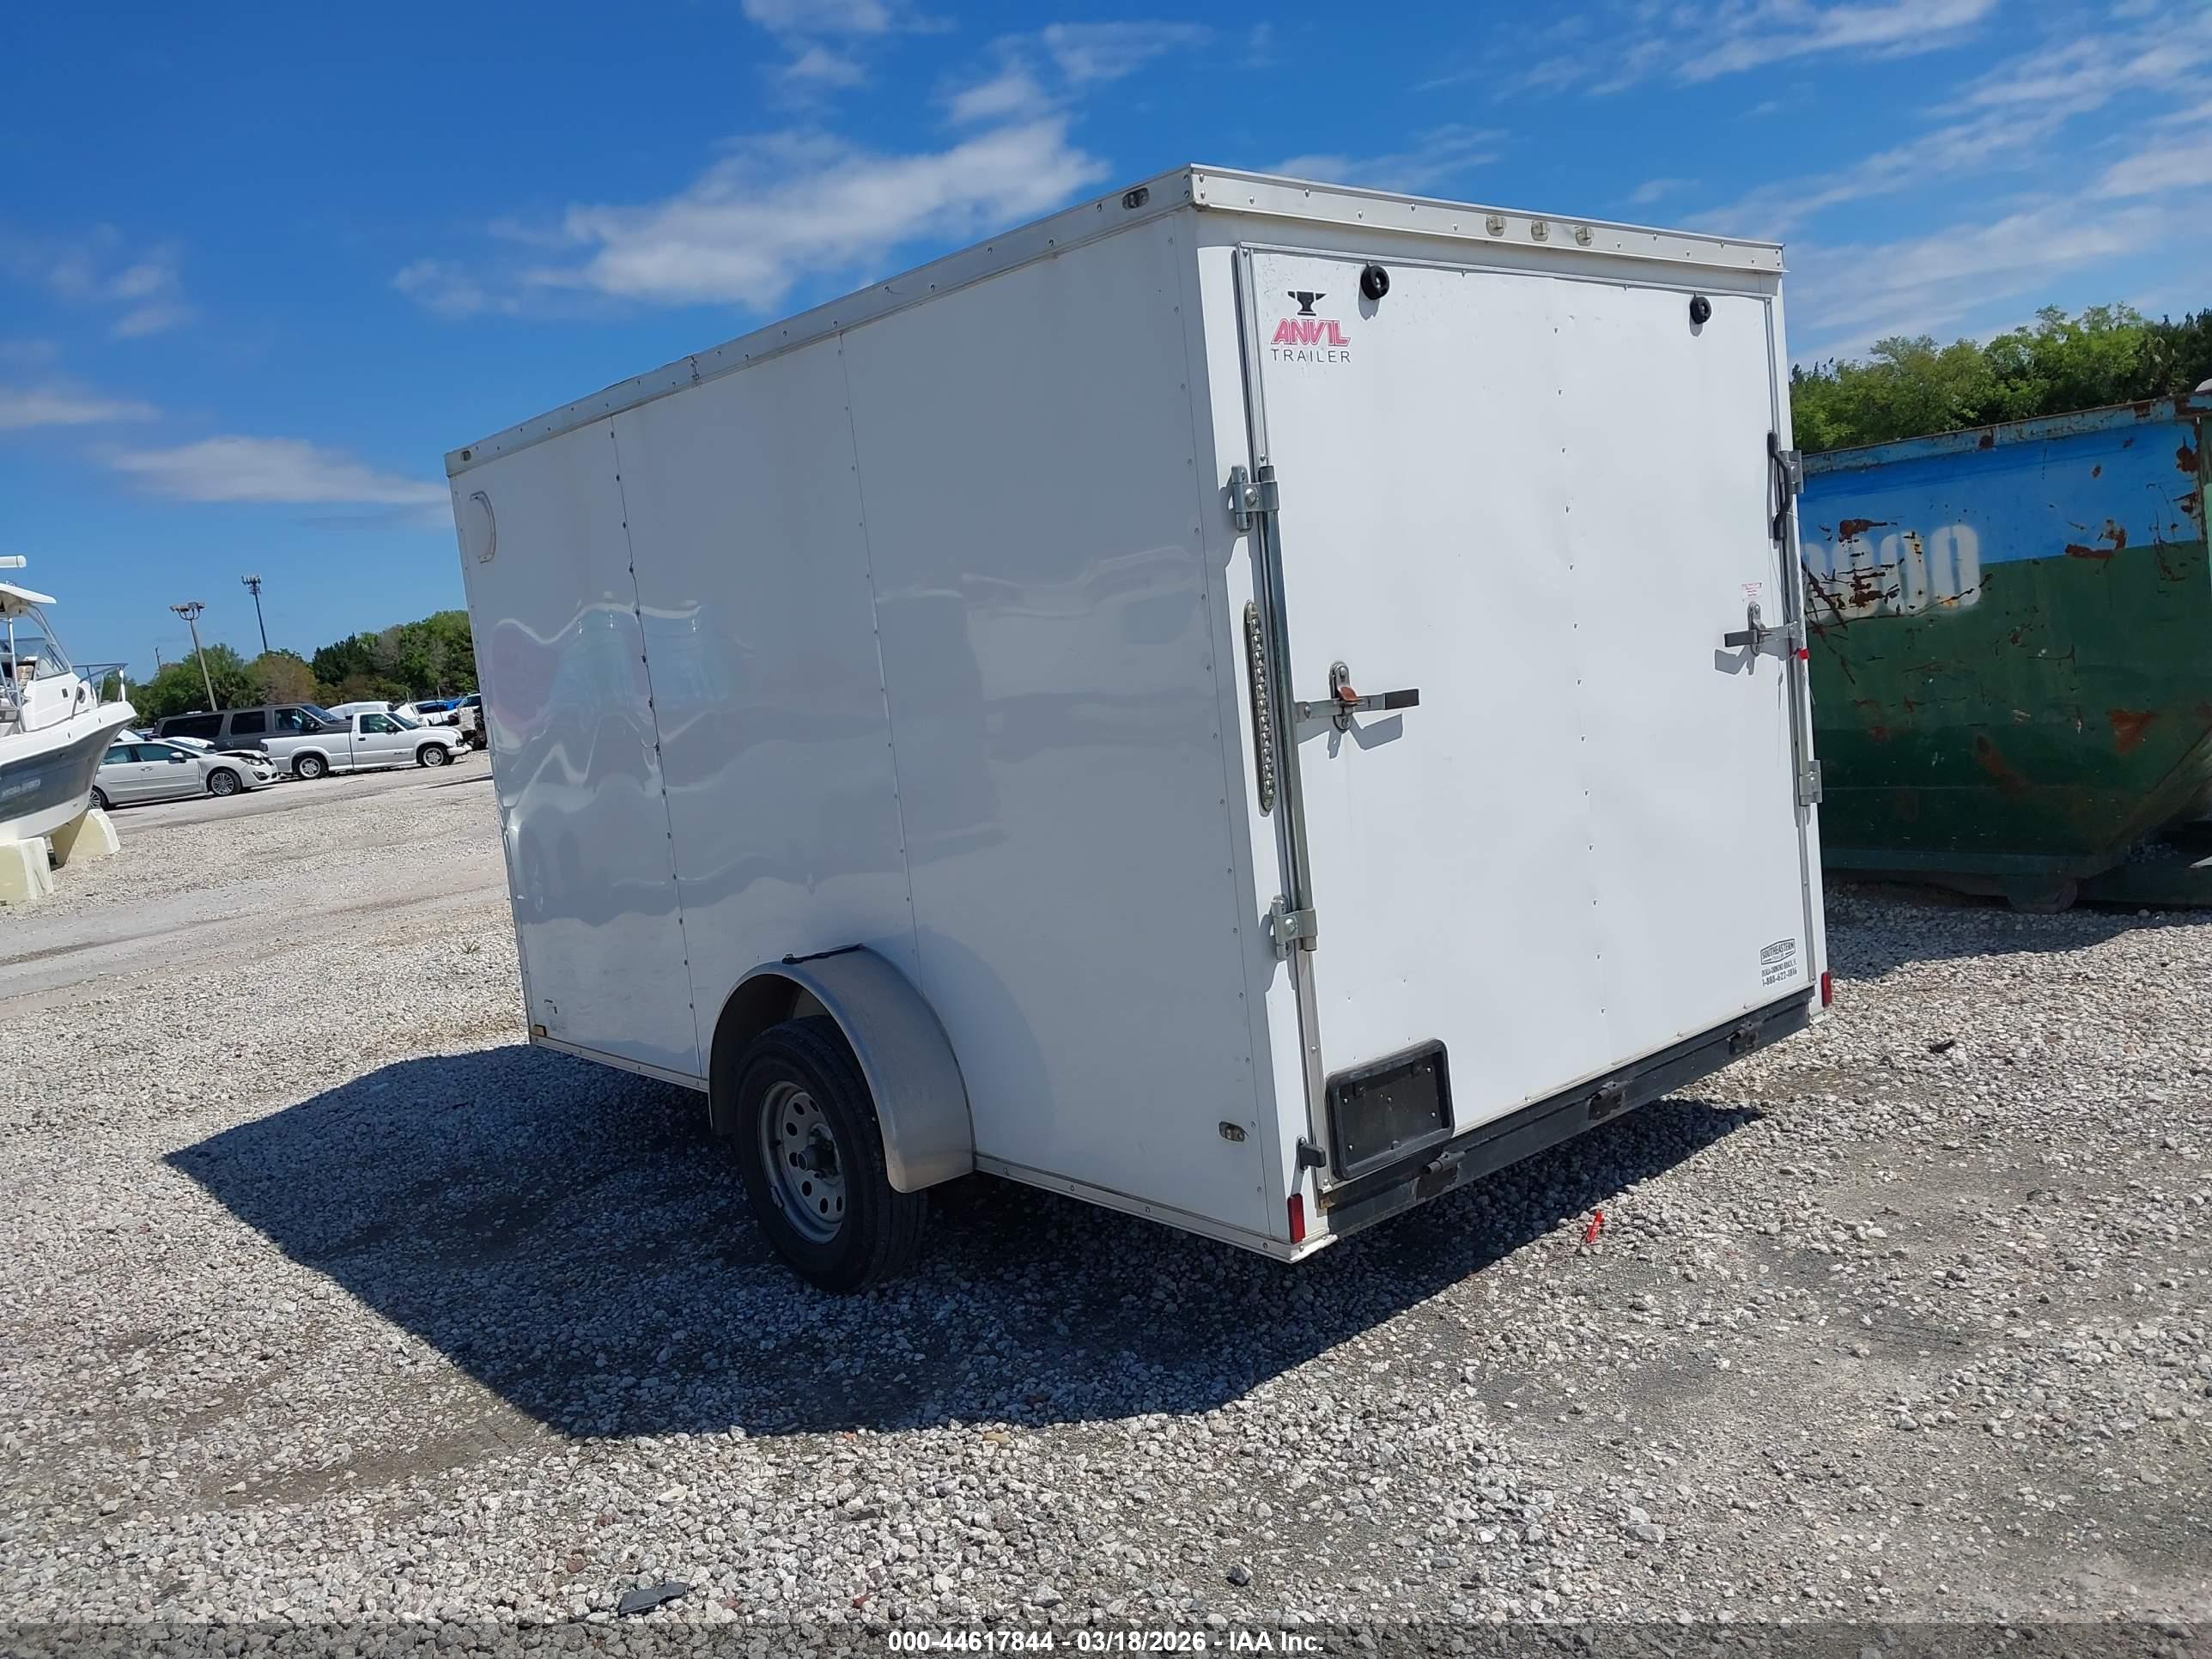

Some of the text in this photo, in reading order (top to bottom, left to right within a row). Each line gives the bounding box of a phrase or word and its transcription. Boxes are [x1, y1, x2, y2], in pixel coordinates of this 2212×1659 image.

[1271, 318, 1351, 347] ANVIL
[1271, 349, 1352, 363] TRAILER
[1761, 941, 1795, 959] SOUTHEASTERN
